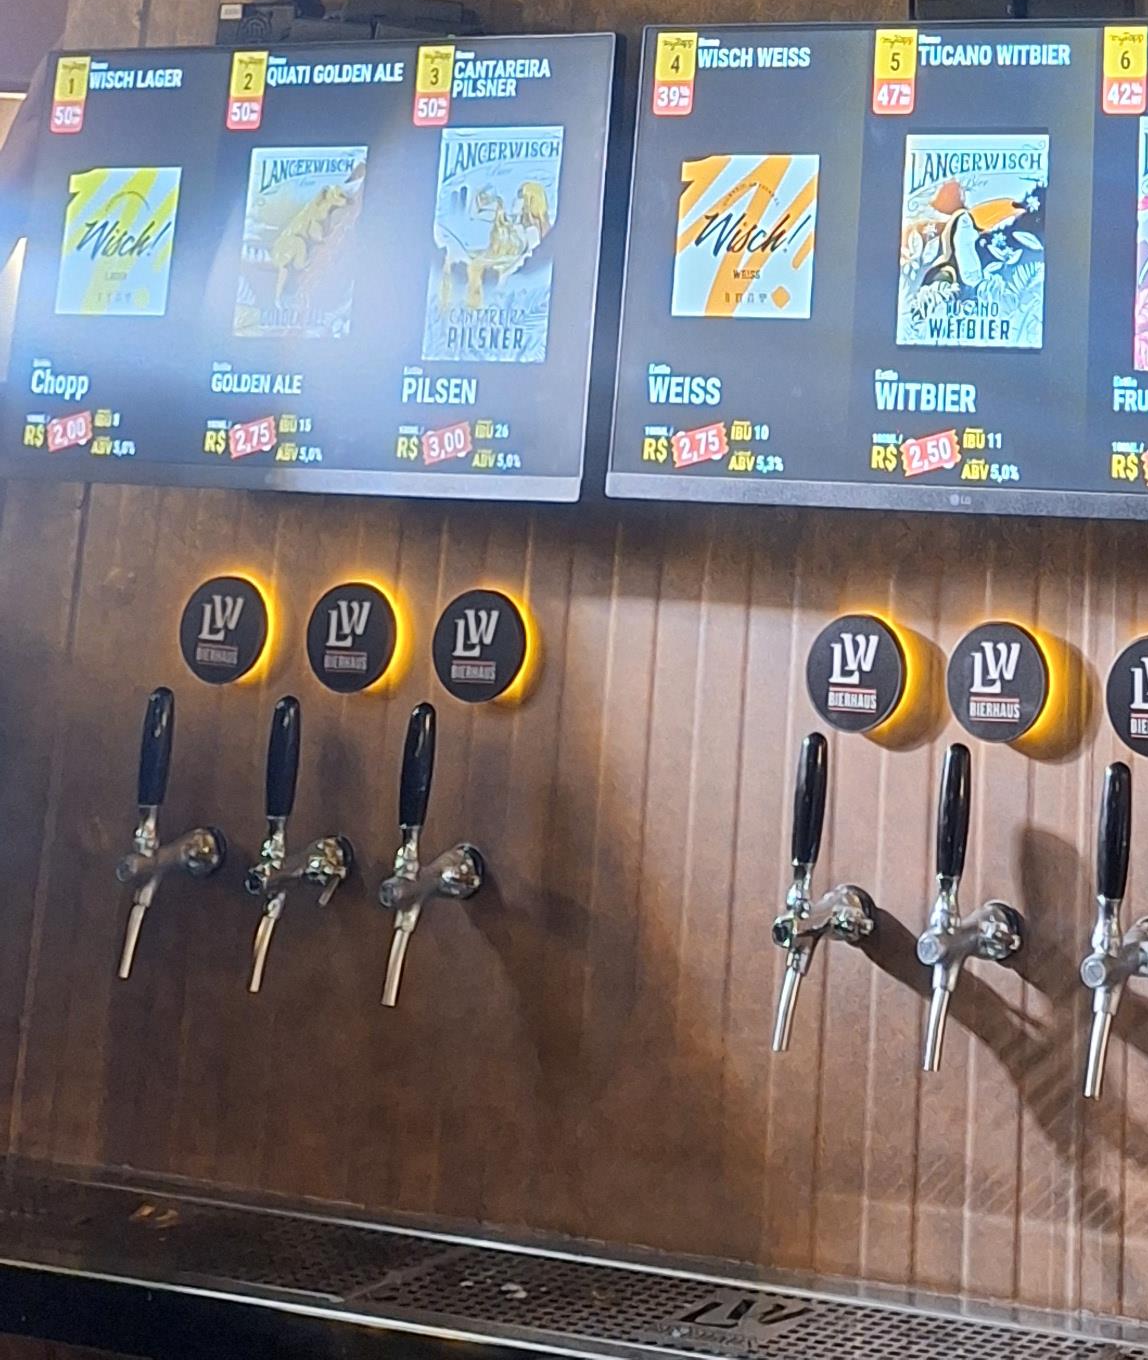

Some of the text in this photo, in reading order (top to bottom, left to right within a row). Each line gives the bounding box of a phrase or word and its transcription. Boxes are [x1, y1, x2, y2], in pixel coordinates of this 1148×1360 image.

[670, 55, 680, 74] 4
[698, 47, 811, 69] WISCH WEISS
[890, 52, 900, 71] 5
[918, 44, 1071, 66] TUCANO WITBIER
[1120, 51, 1131, 70] 6
[89, 69, 183, 90] WISCH LAGER
[266, 62, 404, 87] QUATI GOLDEN ALE
[430, 67, 439, 86] 3
[453, 58, 551, 79] CANTAREIRA
[69, 78, 75, 95] 1
[243, 72, 254, 90] 2
[452, 78, 517, 98] PILSNER
[76, 220, 172, 260] Wisch!
[694, 212, 812, 257] Wisch!
[447, 326, 524, 349] PILSNER
[928, 318, 1011, 340] WITBIER
[31, 368, 89, 401] Chopp
[211, 373, 303, 394] GOLDEN ALE
[402, 377, 478, 404] PILSEN
[648, 376, 721, 405] WEISS
[874, 381, 977, 413] WITBIER
[23, 417, 86, 448] R$ 2,00
[204, 422, 270, 455] R$ 2,75
[730, 425, 769, 441] IBU 10
[962, 432, 1002, 449] IBU 11
[396, 428, 465, 461] R$ 3,00
[642, 430, 720, 463] R$ 2,75
[871, 437, 950, 472] R$ 2,50
[728, 455, 755, 472] ABV
[960, 463, 1020, 484] ABV 5,0%
[1111, 453, 1139, 482] R$
[198, 595, 245, 641] LW
[325, 600, 372, 647] LW
[452, 609, 499, 657] LW
[828, 633, 879, 684] LW
[970, 641, 1021, 693] LW
[828, 691, 877, 710] BIERHAUS
[970, 701, 1020, 719] BIERHAUS
